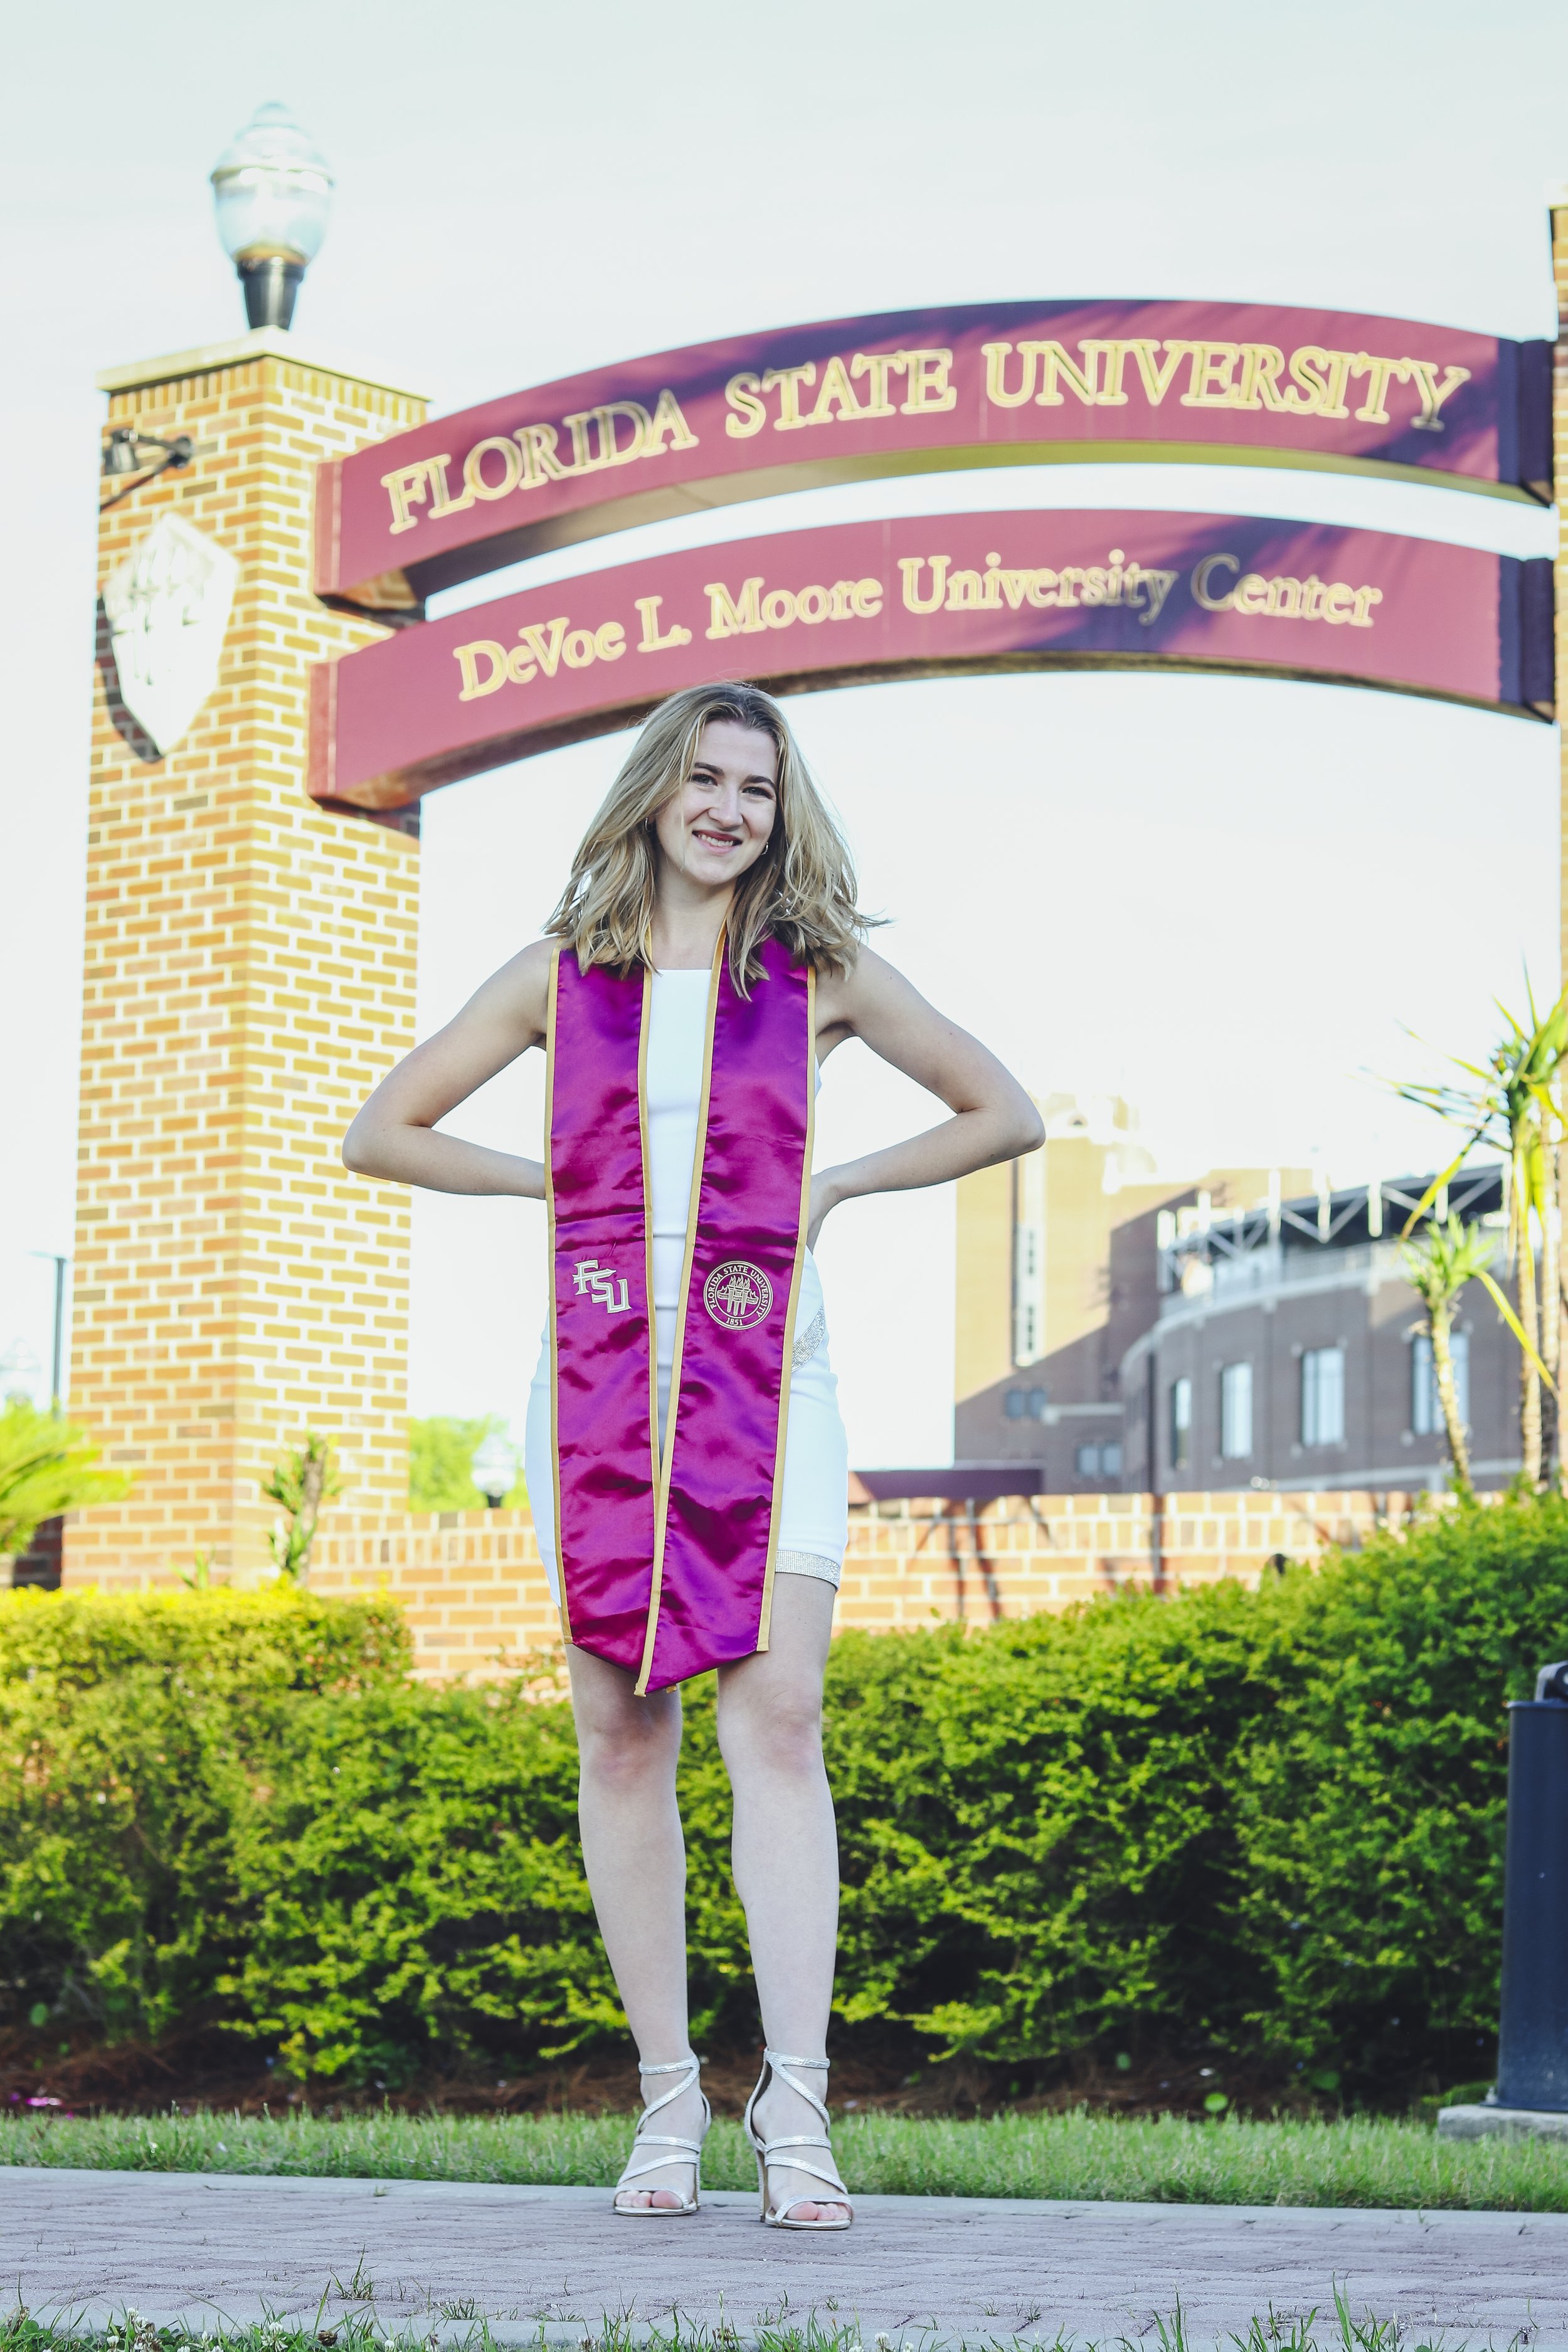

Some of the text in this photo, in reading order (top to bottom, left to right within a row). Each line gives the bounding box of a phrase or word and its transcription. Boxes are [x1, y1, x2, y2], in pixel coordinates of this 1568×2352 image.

[381, 339, 1471, 534] FLORIDA STATE UNIVERSITY
[453, 549, 1383, 702] DeVoe L. Moore University Center
[572, 1259, 632, 1314] FSU
[708, 1265, 769, 1318] FLORIDA STATE UNIVERSITY
[726, 1317, 743, 1326] 1851
